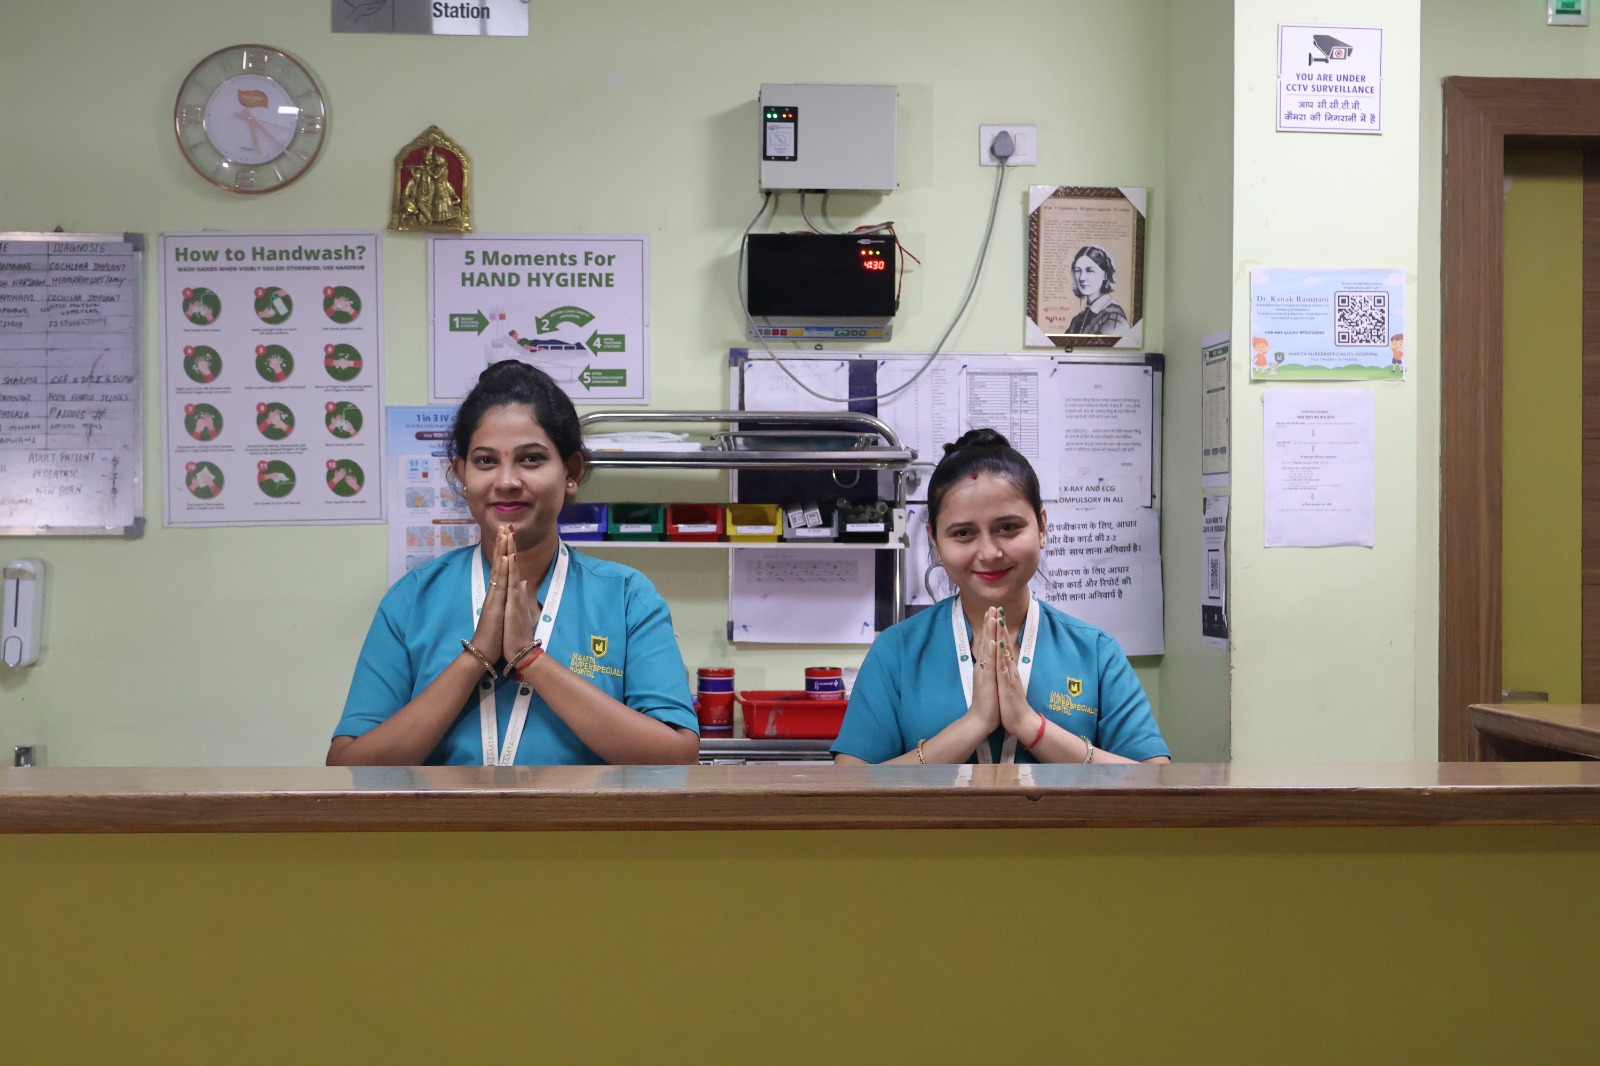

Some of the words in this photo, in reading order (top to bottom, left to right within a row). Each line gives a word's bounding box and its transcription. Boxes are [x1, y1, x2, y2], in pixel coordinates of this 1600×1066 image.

[432, 2, 490, 19] Station
[1295, 73, 1313, 81] YOU
[1336, 74, 1366, 82] UNDER
[1286, 84, 1308, 92] CCTV
[1311, 85, 1375, 94] SURVEILLANCE
[53, 243, 106, 253] DIAGNOSIS
[175, 247, 219, 262] How
[225, 248, 245, 262] to
[252, 245, 366, 262] Handwash?
[465, 250, 475, 266] 5
[482, 250, 578, 266] Moments
[584, 251, 616, 266] For
[864, 261, 885, 270] 4:30
[461, 272, 521, 287] HAND
[527, 272, 615, 287] HYGIENE
[453, 317, 460, 328] 1
[541, 319, 550, 331] 2
[592, 337, 602, 348] 4
[583, 372, 591, 384] 5
[417, 414, 420, 422] 1
[423, 414, 431, 422] in
[433, 414, 438, 422] 3
[440, 414, 449, 422] IV
[29, 453, 56, 463] ADULT
[60, 452, 95, 462] PATIENT
